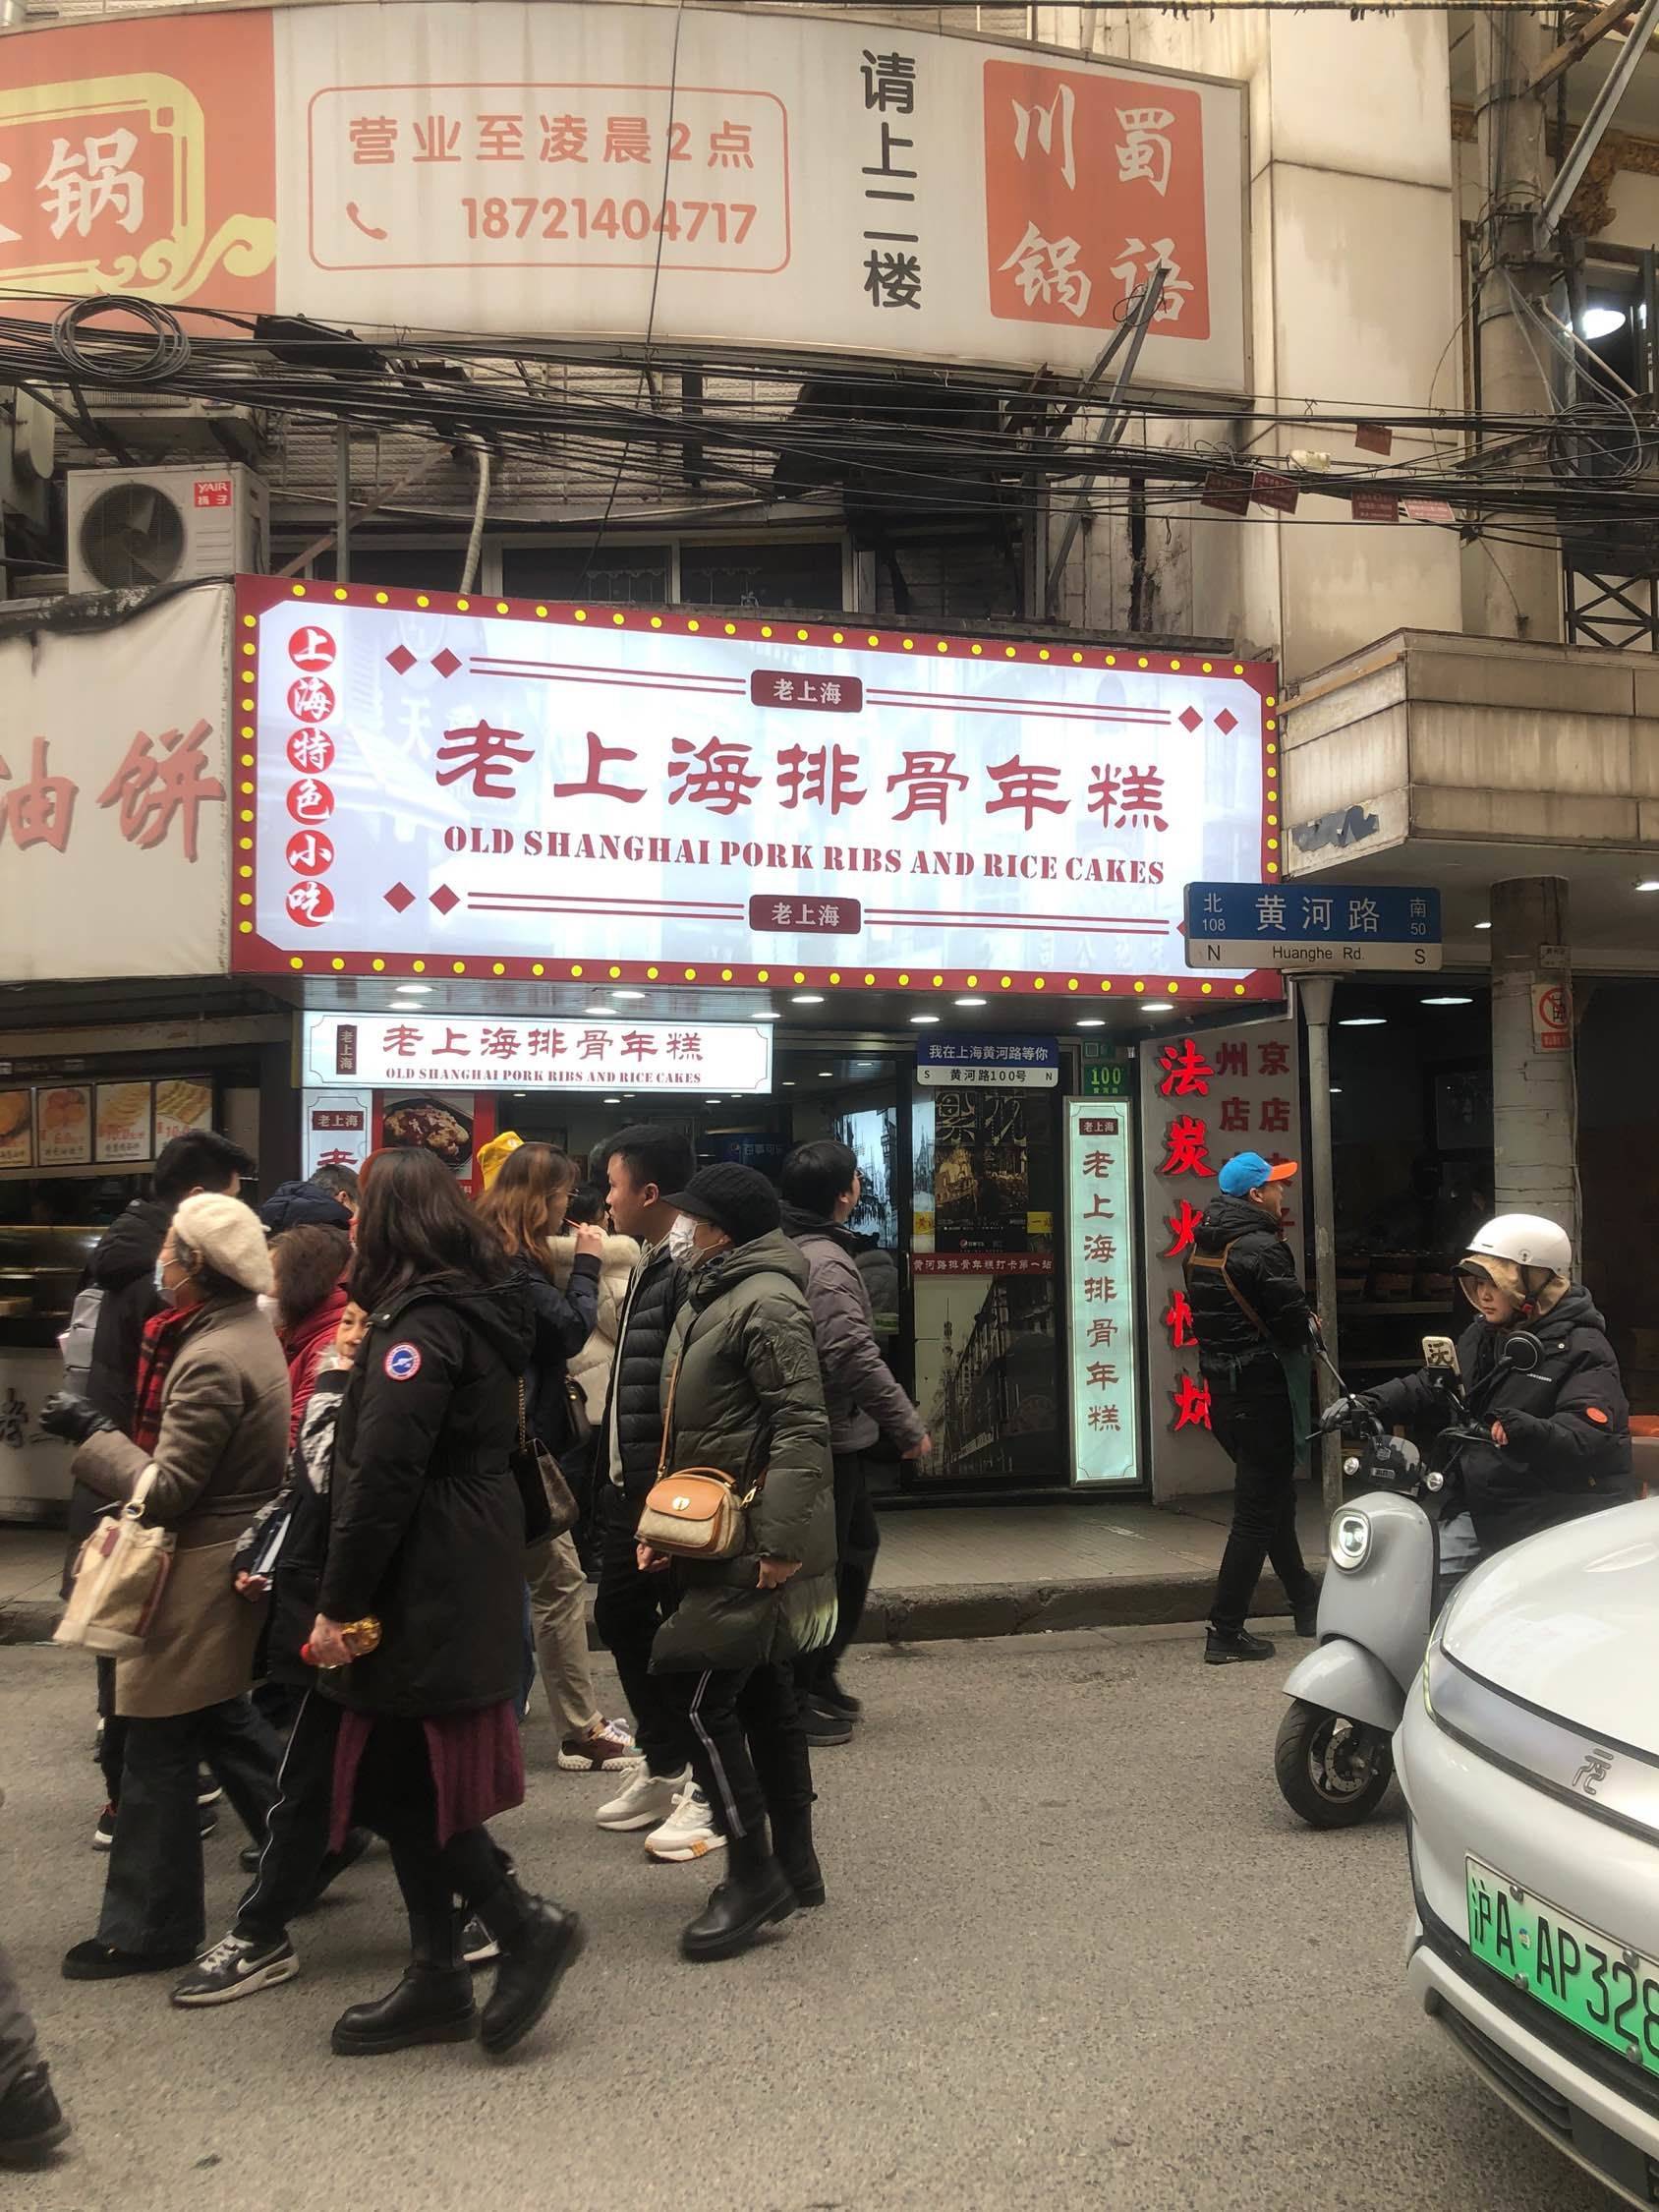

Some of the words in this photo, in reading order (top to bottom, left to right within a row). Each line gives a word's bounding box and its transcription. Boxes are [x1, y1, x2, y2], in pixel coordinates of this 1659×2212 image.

[349, 113, 754, 169] 营业至凌晨2点
[0, 127, 145, 242] 锅
[861, 49, 921, 311] 请上二楼
[461, 197, 757, 245] 18721404717
[198, 482, 228, 494] YAIR
[772, 678, 842, 705] 老上海
[286, 629, 335, 924] 上海特色小吃
[435, 719, 1170, 833] 老上海排骨年糕
[444, 826, 514, 853] OLD
[524, 831, 709, 865] SHANGHAI
[719, 842, 814, 869] PORK
[824, 845, 901, 873] RIBS
[910, 850, 974, 876] AND
[984, 853, 1058, 880] RICE
[1065, 857, 1165, 885] CAKES
[1203, 893, 1223, 913] 北
[1409, 897, 1428, 918] 南
[772, 902, 840, 927] 老上海
[1255, 896, 1380, 933] 黄河路
[1202, 918, 1226, 932] 108
[1409, 922, 1427, 936] 50
[1207, 944, 1221, 961] N
[1272, 946, 1333, 962] Huanghe
[1343, 947, 1365, 960] Rd.
[1414, 948, 1427, 965] S
[338, 1029, 355, 1071] 老上海
[382, 1023, 704, 1061] 老上海排骨年糕
[929, 1044, 1050, 1061] 我在上海黄河路等你
[386, 1068, 415, 1079] OLD
[419, 1068, 498, 1081] SHANGHAI
[502, 1070, 544, 1082] PORK
[548, 1070, 584, 1082] RIBS
[589, 1072, 616, 1083] AND
[619, 1072, 654, 1083] RICE
[657, 1073, 702, 1084] CAKES
[924, 1070, 931, 1079] S
[950, 1069, 1027, 1082] 黄河路100号
[1046, 1072, 1053, 1081] N
[1091, 1068, 1120, 1084] 100
[317, 1114, 360, 1128] 老上海
[1083, 1121, 1116, 1133] 老上海
[1082, 1150, 1121, 1432] 老上海排骨年糕
